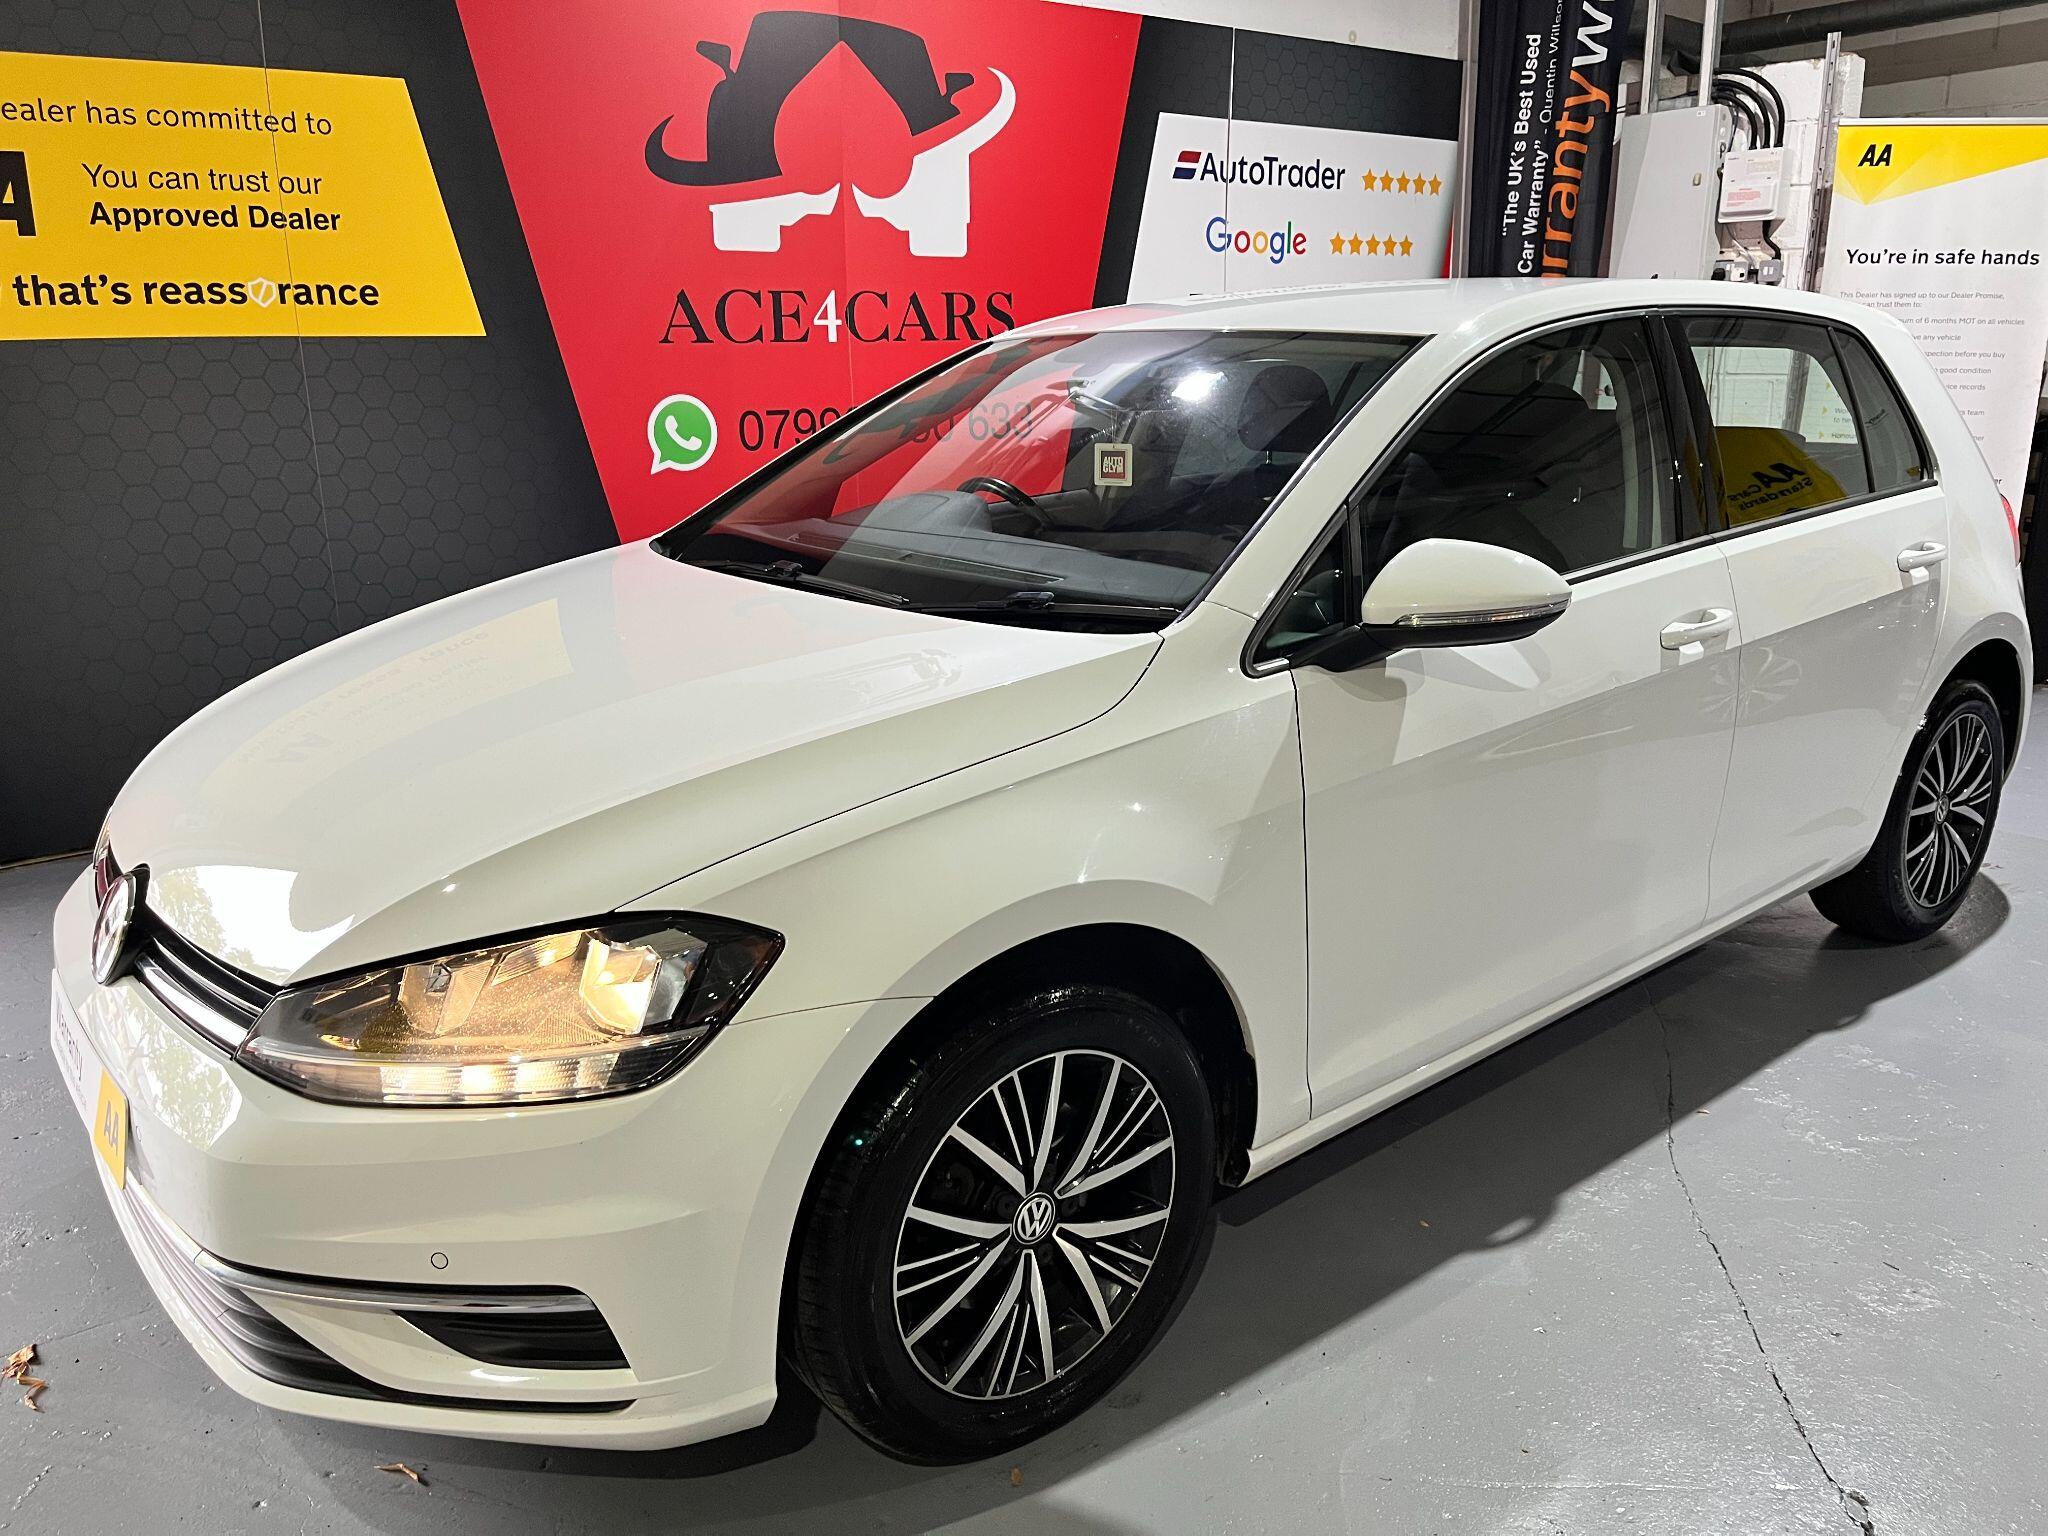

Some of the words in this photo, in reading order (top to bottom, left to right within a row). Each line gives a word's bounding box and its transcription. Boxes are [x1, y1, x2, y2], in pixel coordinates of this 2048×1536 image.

[1520, 34, 1541, 84] Used
[1, 97, 77, 124] ealer
[85, 100, 137, 126] has
[146, 106, 297, 134] committed
[304, 112, 334, 136] to
[1514, 90, 1533, 135] Best
[1517, 240, 1535, 274] Car
[1539, 58, 1557, 123] Quentin
[1548, 0, 1563, 54] Willso
[1200, 152, 1346, 190] AutoTrader
[1857, 143, 1893, 168] AA
[81, 163, 138, 189] You
[148, 170, 199, 191] can
[208, 168, 271, 194] trust
[279, 174, 323, 196] our
[89, 200, 239, 232] Approved
[248, 204, 342, 232] Dealer
[1205, 216, 1307, 264] Google
[1911, 249, 1929, 265] in
[1934, 249, 1976, 265] safe
[1981, 250, 2041, 266] hands
[1839, 291, 1854, 299] This
[1855, 291, 1878, 299] Dealer
[1879, 291, 1892, 299] has
[1893, 291, 1917, 300] signed
[1917, 292, 1928, 300] up
[1928, 291, 1937, 299] to
[1950, 291, 1974, 299] Dealer
[658, 288, 1015, 345] ACE4CARS
[1931, 317, 1957, 325] months
[1997, 318, 2026, 326] vehicles
[1954, 350, 1978, 358] before
[1992, 351, 2007, 359] buy
[1939, 367, 1958, 375] good
[1959, 367, 1992, 375] condition
[1959, 383, 1986, 391] records
